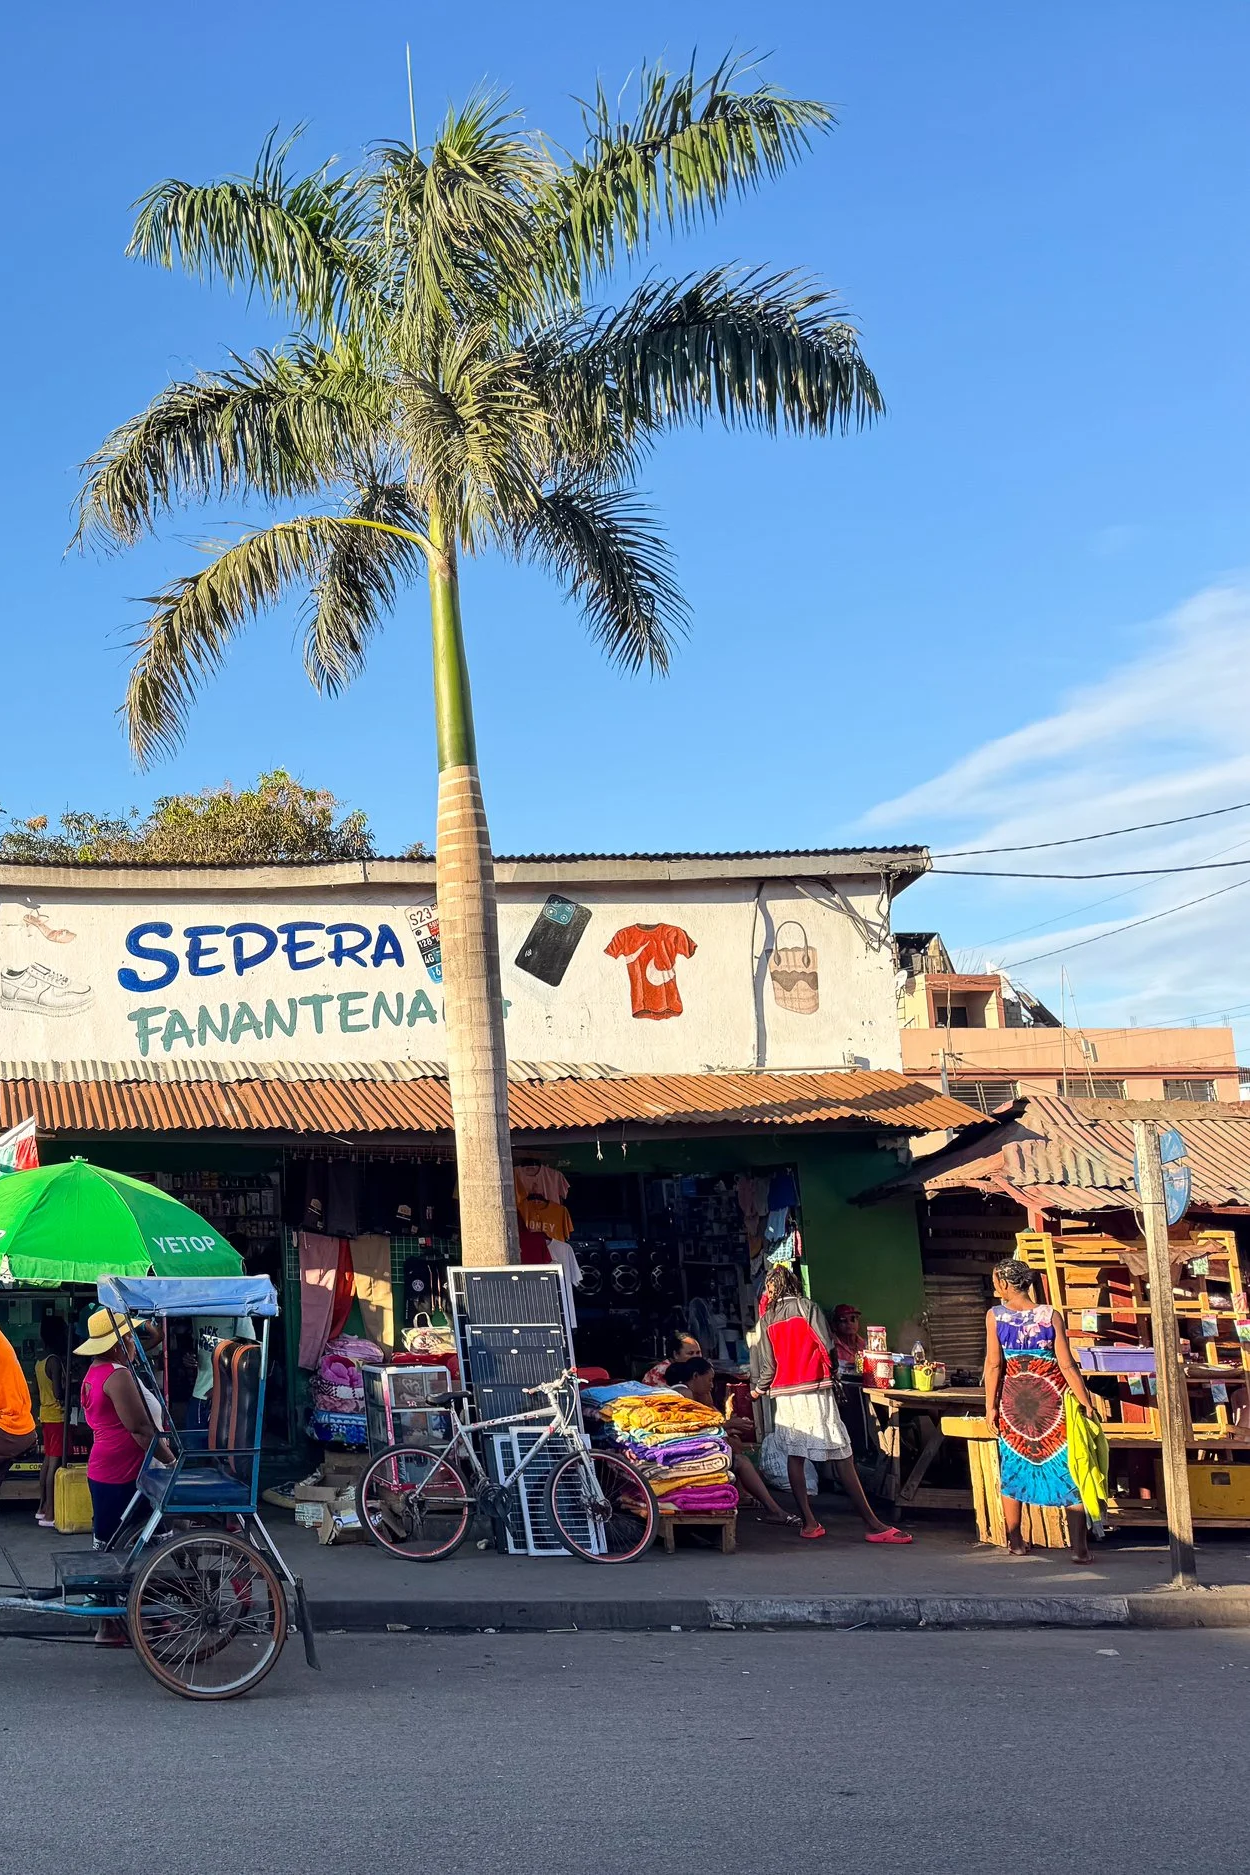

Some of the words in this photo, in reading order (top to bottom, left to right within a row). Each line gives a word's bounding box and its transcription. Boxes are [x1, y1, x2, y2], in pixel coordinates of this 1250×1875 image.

[410, 907, 432, 925] S23
[418, 937, 433, 948] 128
[117, 921, 405, 993] SEDERA
[424, 953, 435, 964] 4G
[127, 988, 513, 1056] FANANTENA
[151, 1236, 216, 1253] YETOP
